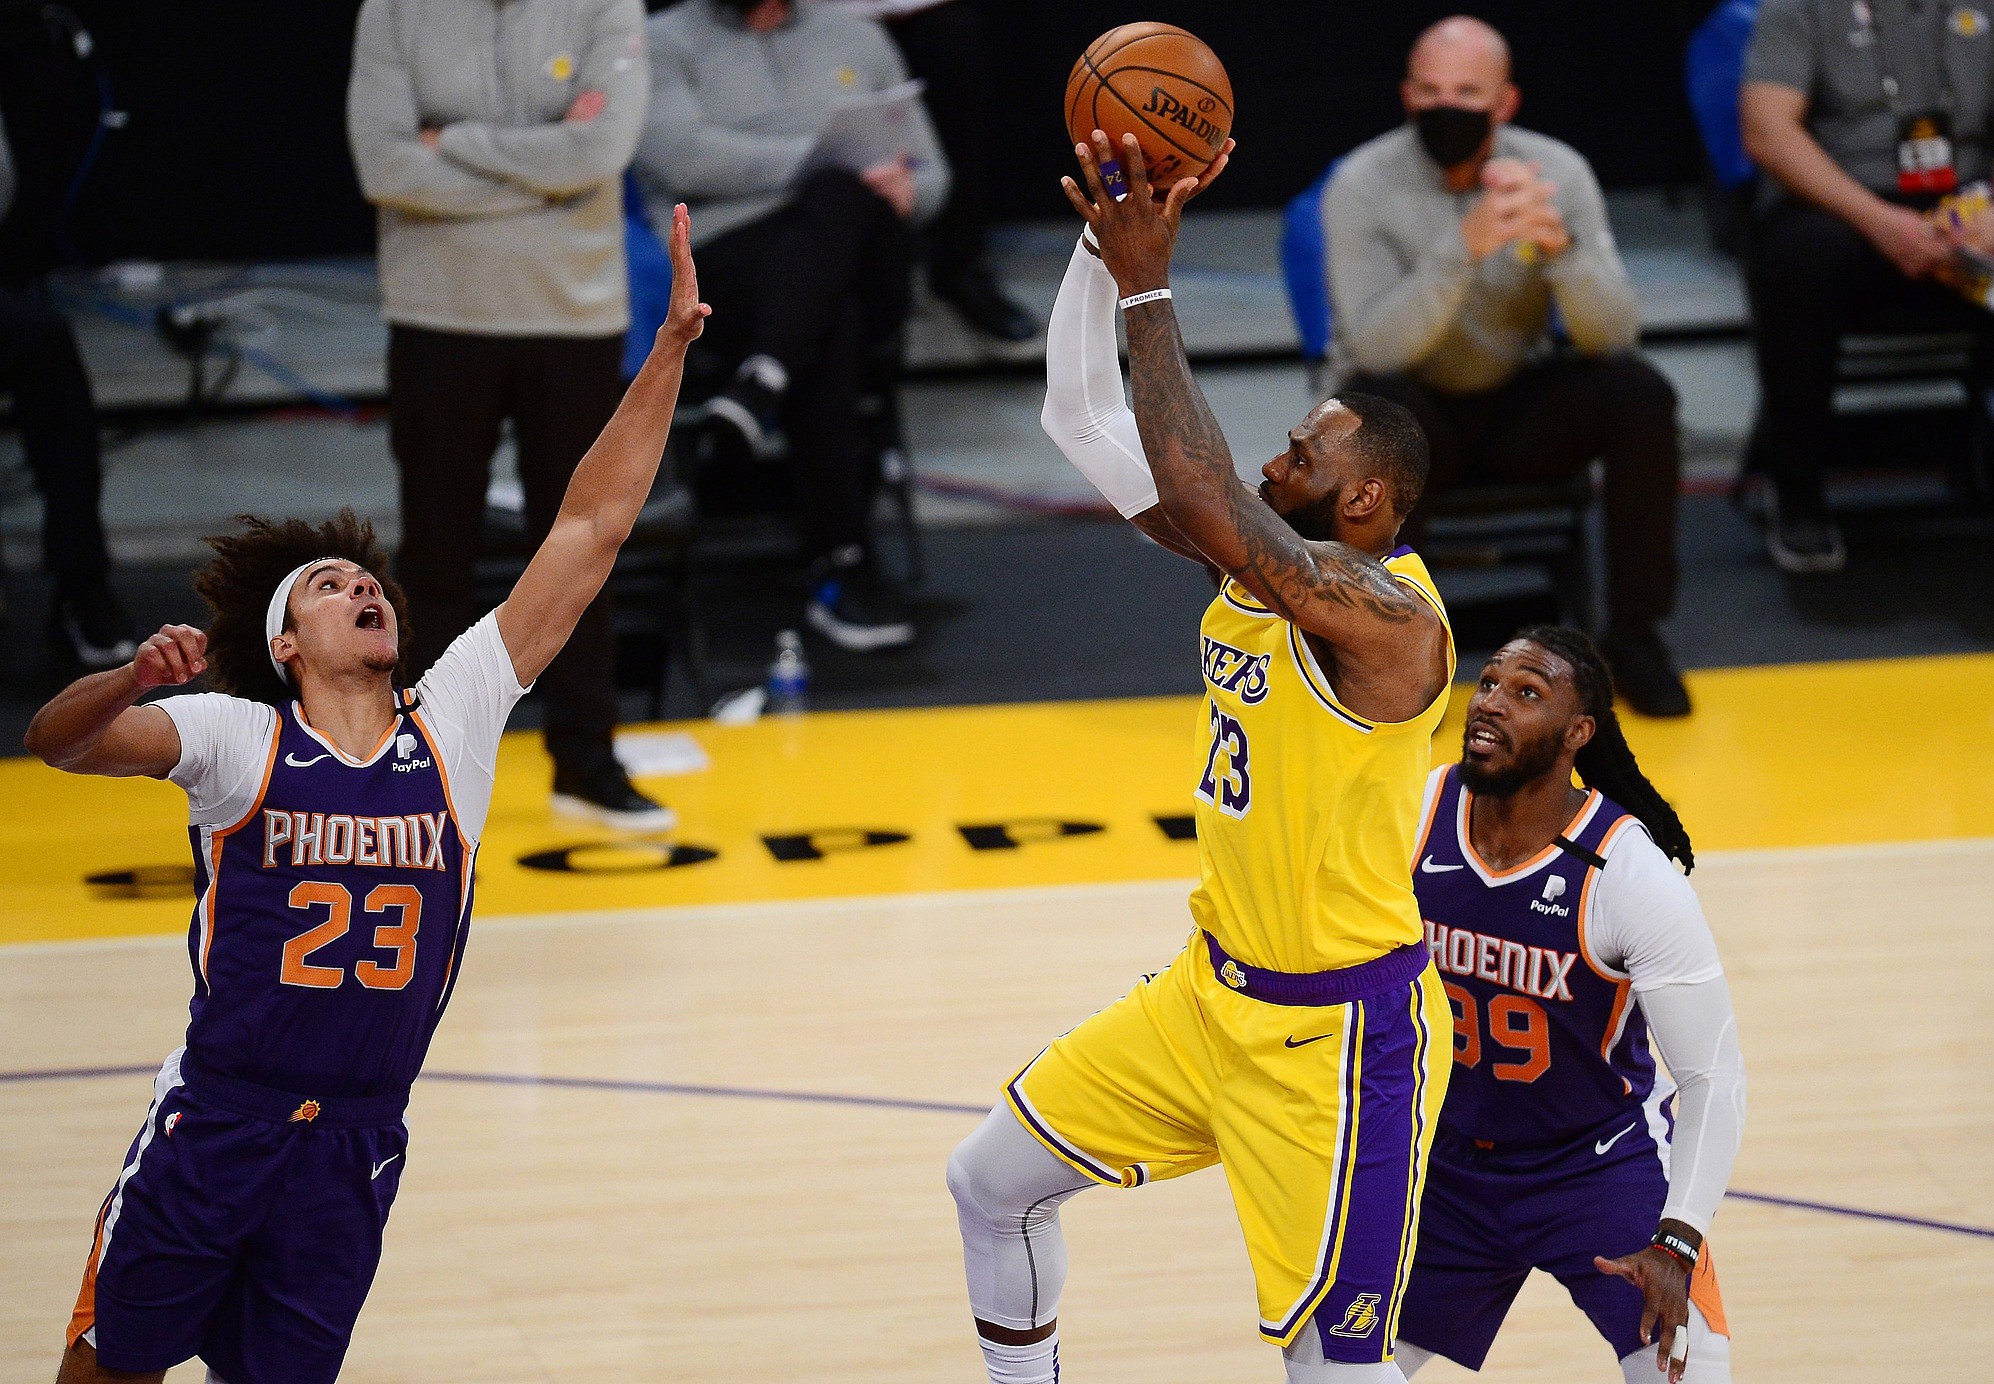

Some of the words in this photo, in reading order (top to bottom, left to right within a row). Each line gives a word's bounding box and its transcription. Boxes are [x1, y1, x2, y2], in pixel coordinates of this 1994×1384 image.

[1142, 86, 1226, 151] SPALDIN
[1202, 634, 1271, 705] KERS
[392, 756, 431, 773] PayPal
[1194, 697, 1252, 820] 23
[262, 808, 448, 872] PHOENIX
[280, 880, 423, 991] 23
[1530, 899, 1569, 918] PayPal
[1423, 919, 1578, 1001] HOENIX
